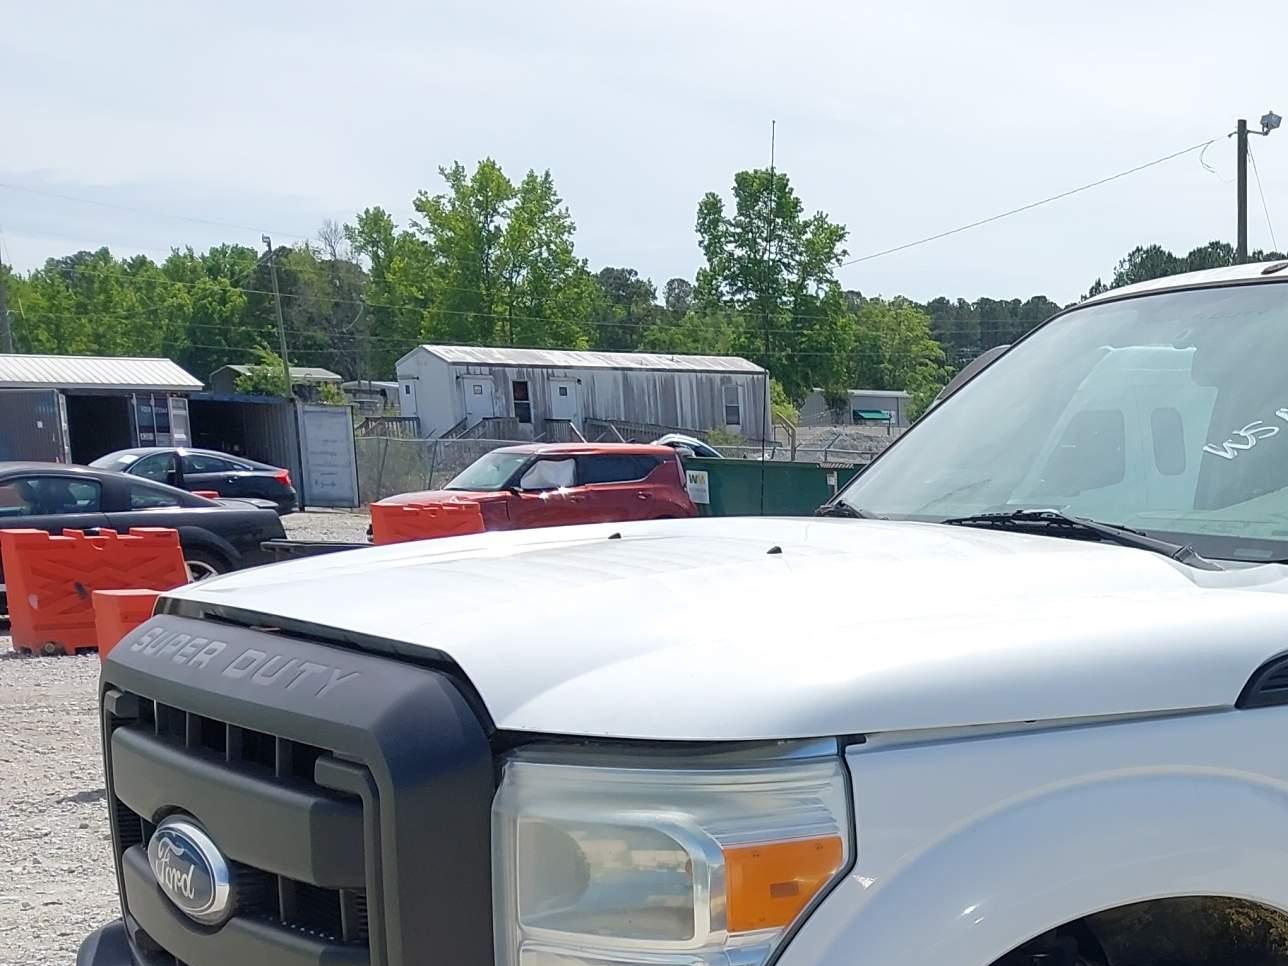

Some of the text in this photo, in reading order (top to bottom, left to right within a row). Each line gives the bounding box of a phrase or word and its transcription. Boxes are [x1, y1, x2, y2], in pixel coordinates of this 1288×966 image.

[131, 628, 361, 697] SUPER DUTY
[155, 837, 195, 899] Ford
